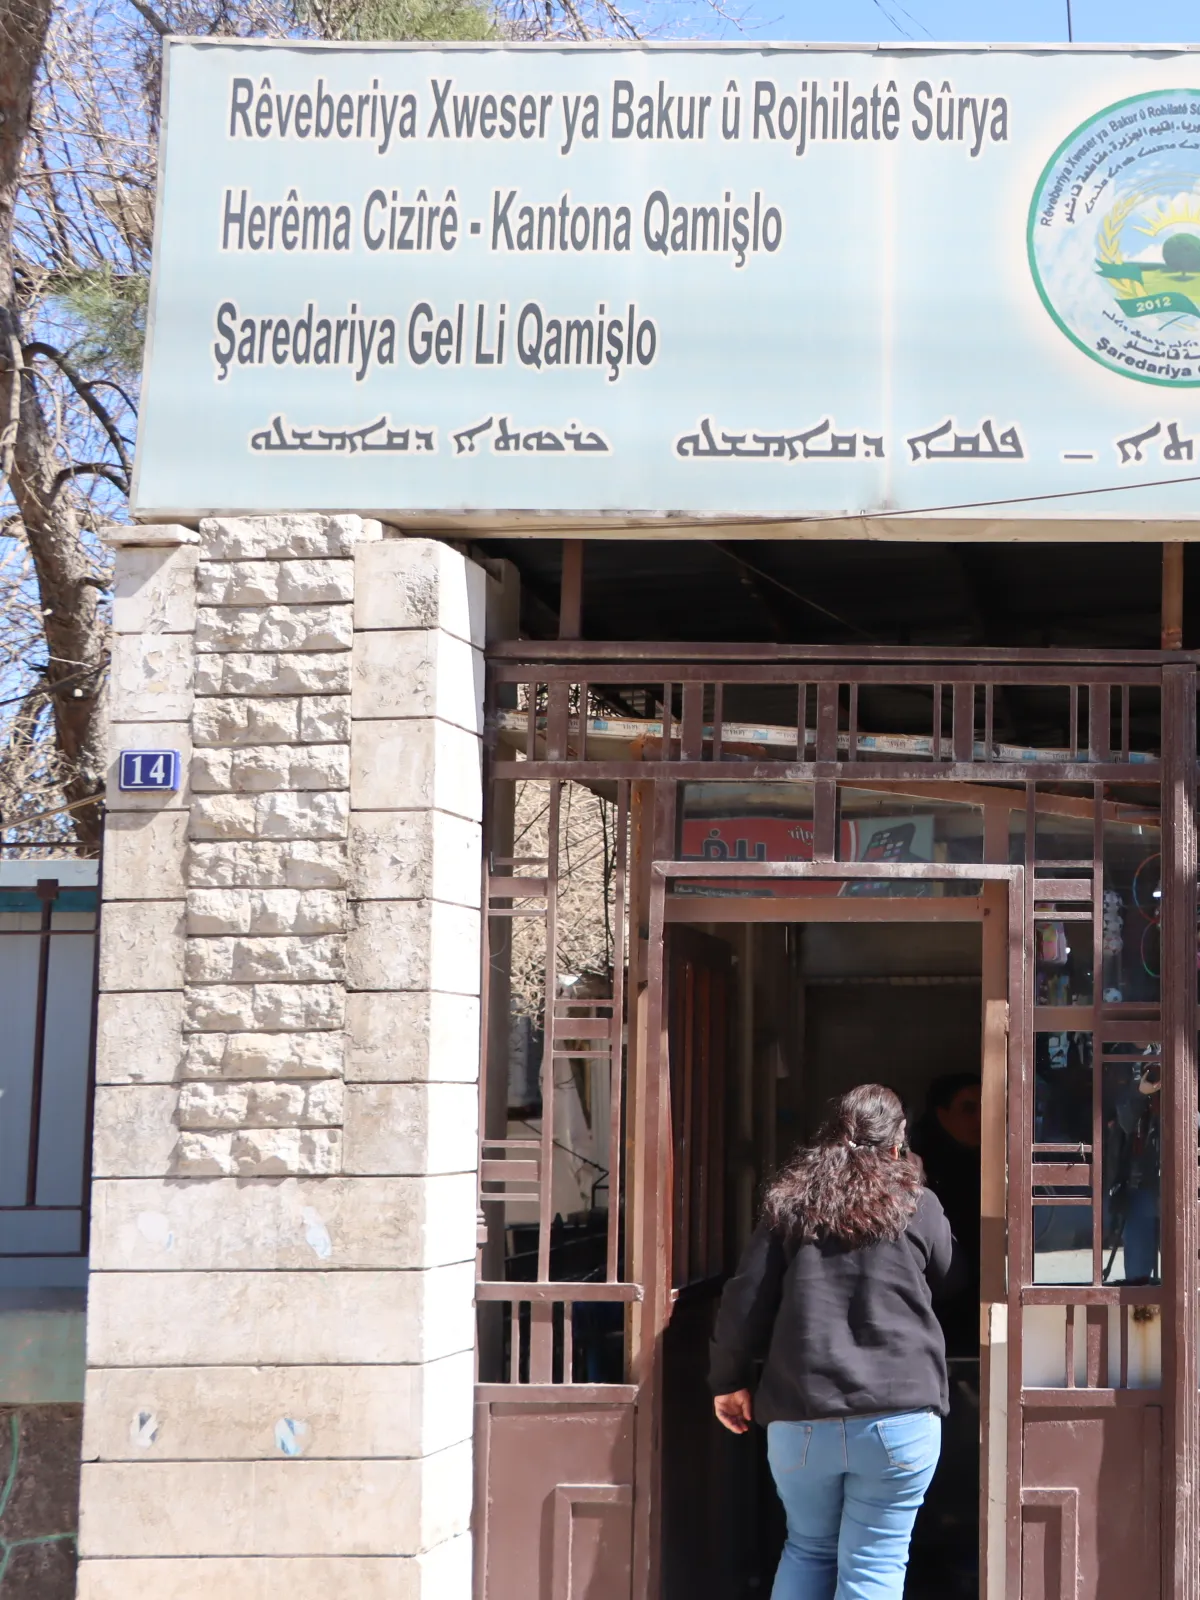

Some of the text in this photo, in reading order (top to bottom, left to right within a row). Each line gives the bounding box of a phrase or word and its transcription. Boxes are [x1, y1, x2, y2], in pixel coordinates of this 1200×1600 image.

[230, 78, 1007, 157] Rêveberiya Xweser ya Bakur û Rojhilatê Sûrya
[1109, 113, 1138, 132] Bakur
[223, 190, 350, 250] Herêma
[364, 190, 457, 250] Cizîrê
[492, 191, 630, 251] Kantona
[644, 191, 781, 267] Qamişlo
[1136, 296, 1172, 312] 2012
[215, 302, 656, 381] Şaredariya Gel Li Qamişlo
[1096, 336, 1192, 379] Şaredariya
[131, 755, 166, 785] 14
